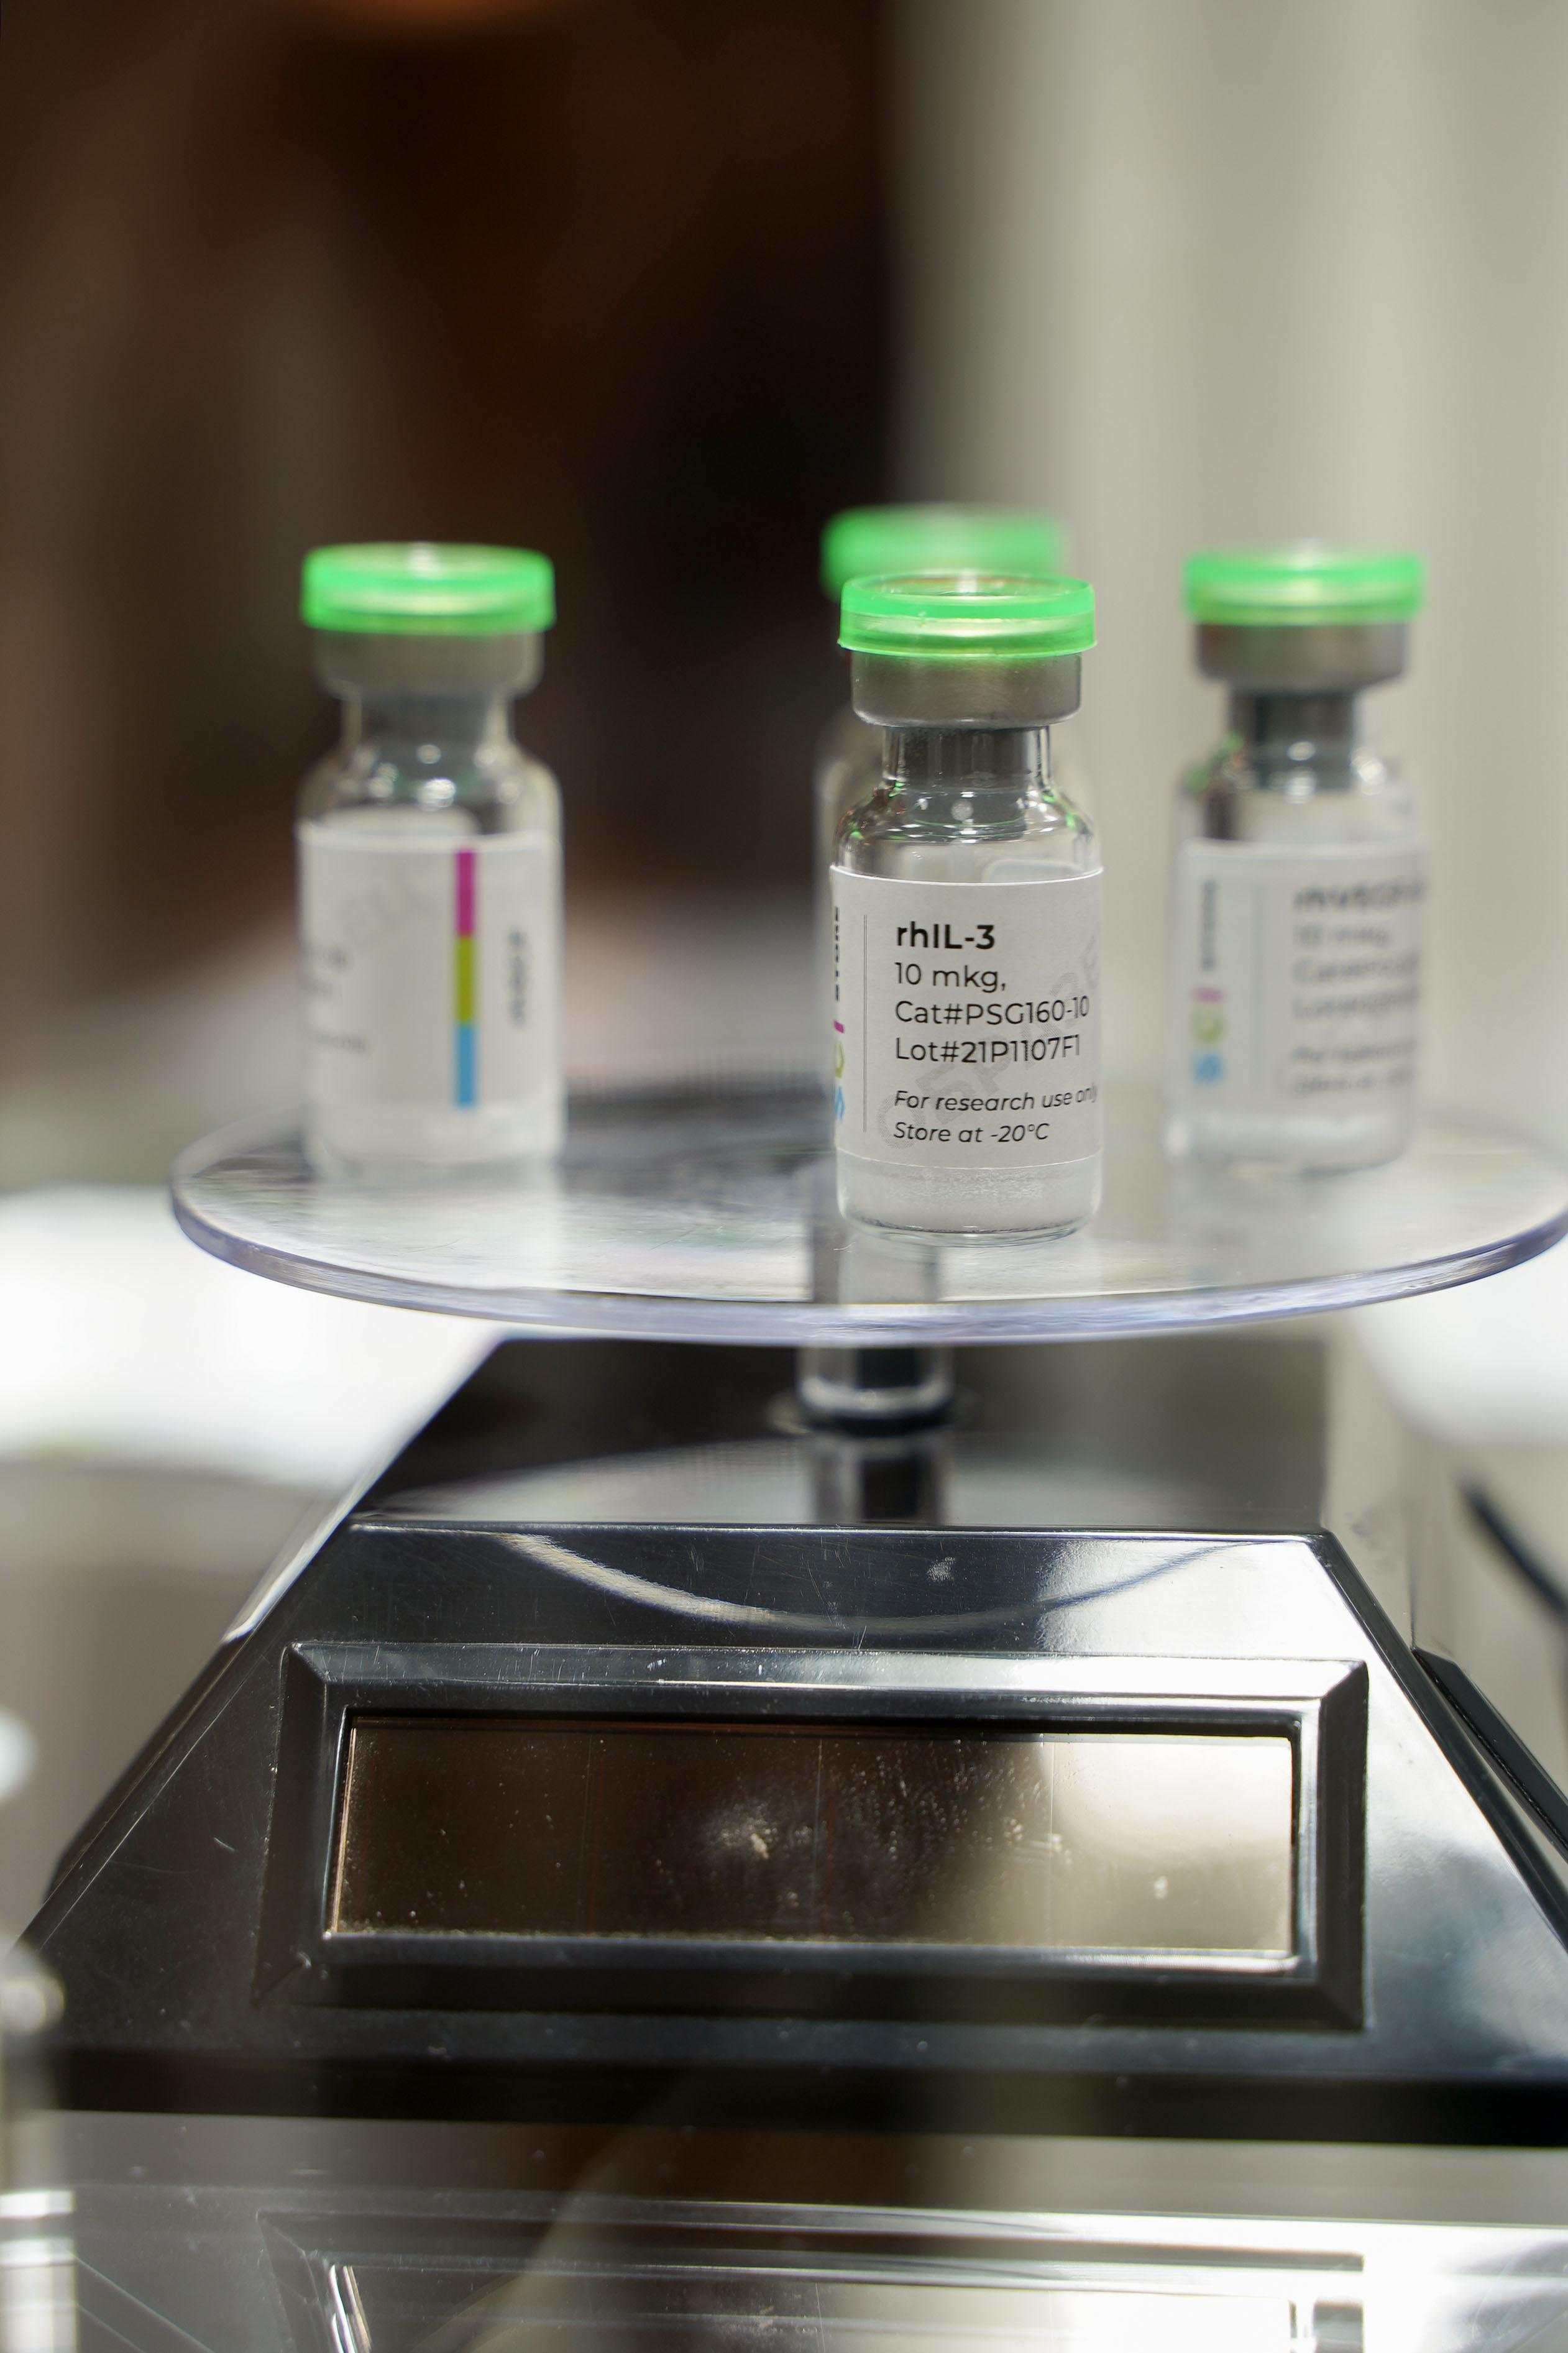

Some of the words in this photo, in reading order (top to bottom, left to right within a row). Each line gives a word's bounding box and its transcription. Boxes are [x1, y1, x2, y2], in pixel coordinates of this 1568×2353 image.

[897, 920, 996, 950] rhIL-3
[894, 961, 922, 985] 10
[932, 965, 1006, 993] mkg,
[895, 995, 1089, 1025] Cat#PSG160-10
[895, 1034, 1080, 1063] Lot#21P1107F1
[894, 1090, 930, 1109] For
[935, 1092, 1035, 1111] research
[1042, 1092, 1073, 1108] use
[892, 1121, 951, 1142] Store
[958, 1127, 984, 1142] at
[991, 1122, 1050, 1143] -20°C
